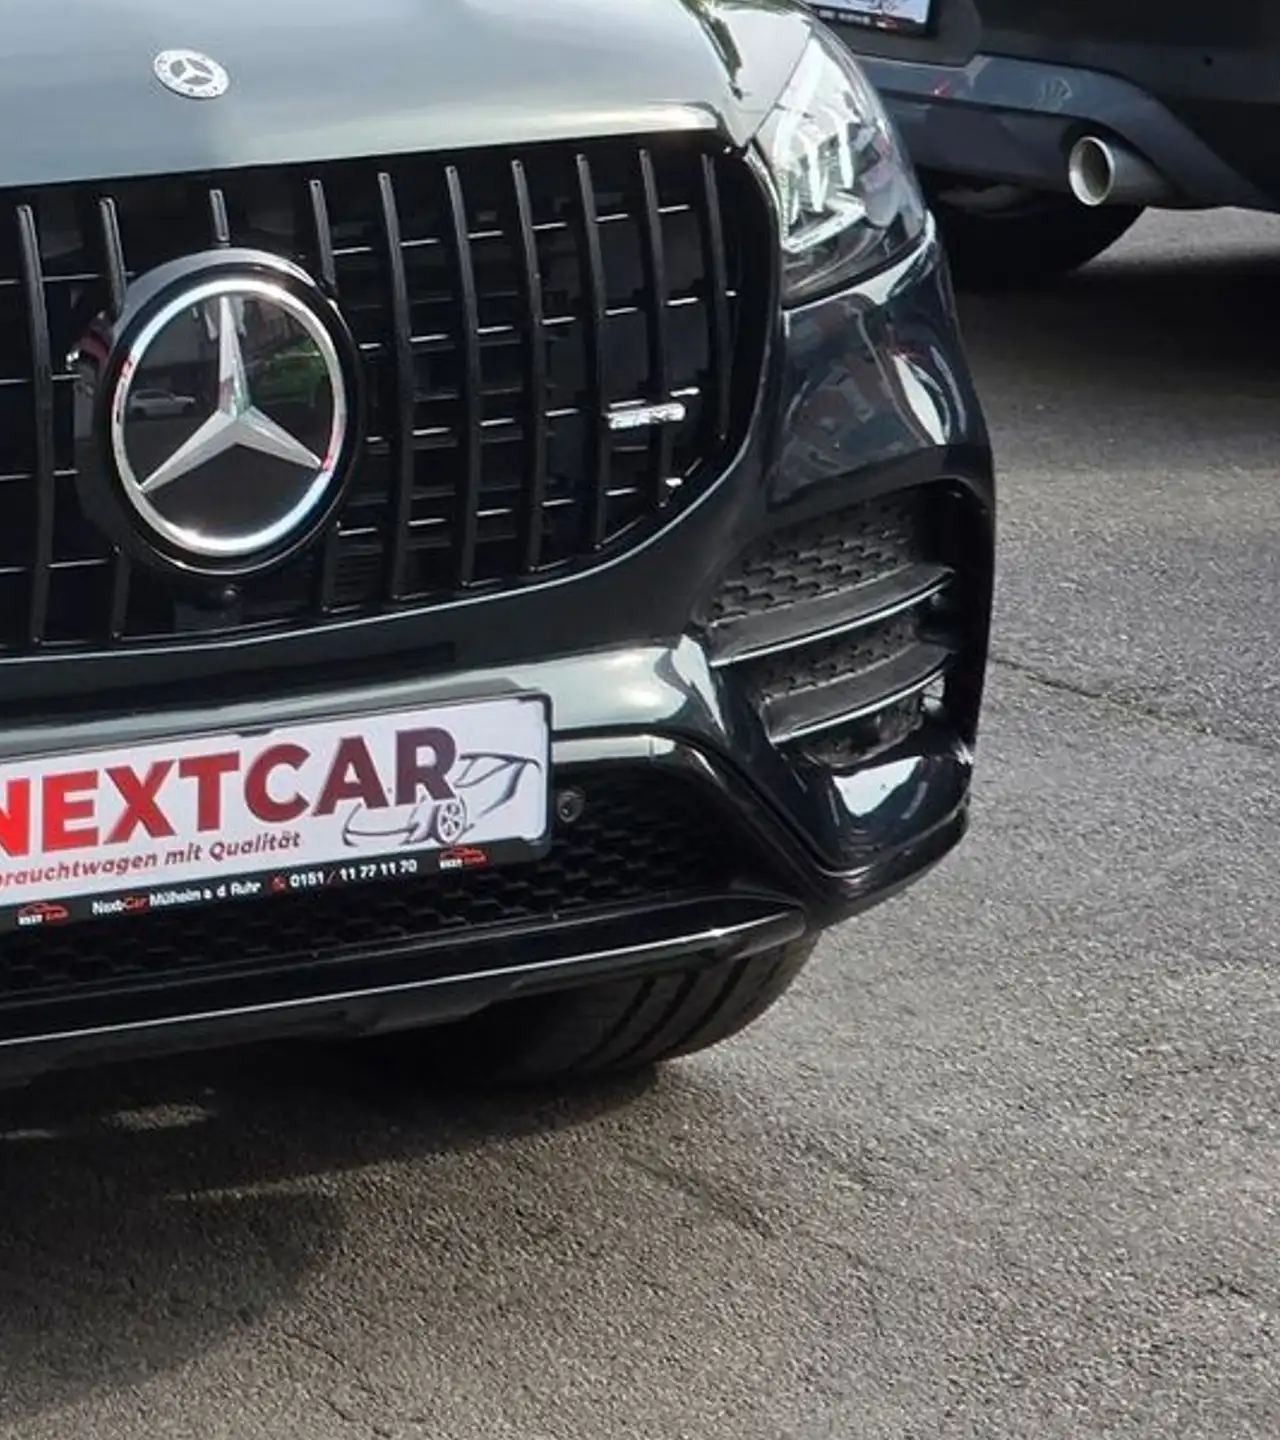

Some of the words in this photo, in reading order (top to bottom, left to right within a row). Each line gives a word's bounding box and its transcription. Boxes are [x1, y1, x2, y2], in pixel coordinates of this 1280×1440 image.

[164, 843, 203, 866] mit
[209, 831, 302, 862] Qualität
[231, 879, 263, 897] Ruhr
[290, 869, 324, 888] 0151
